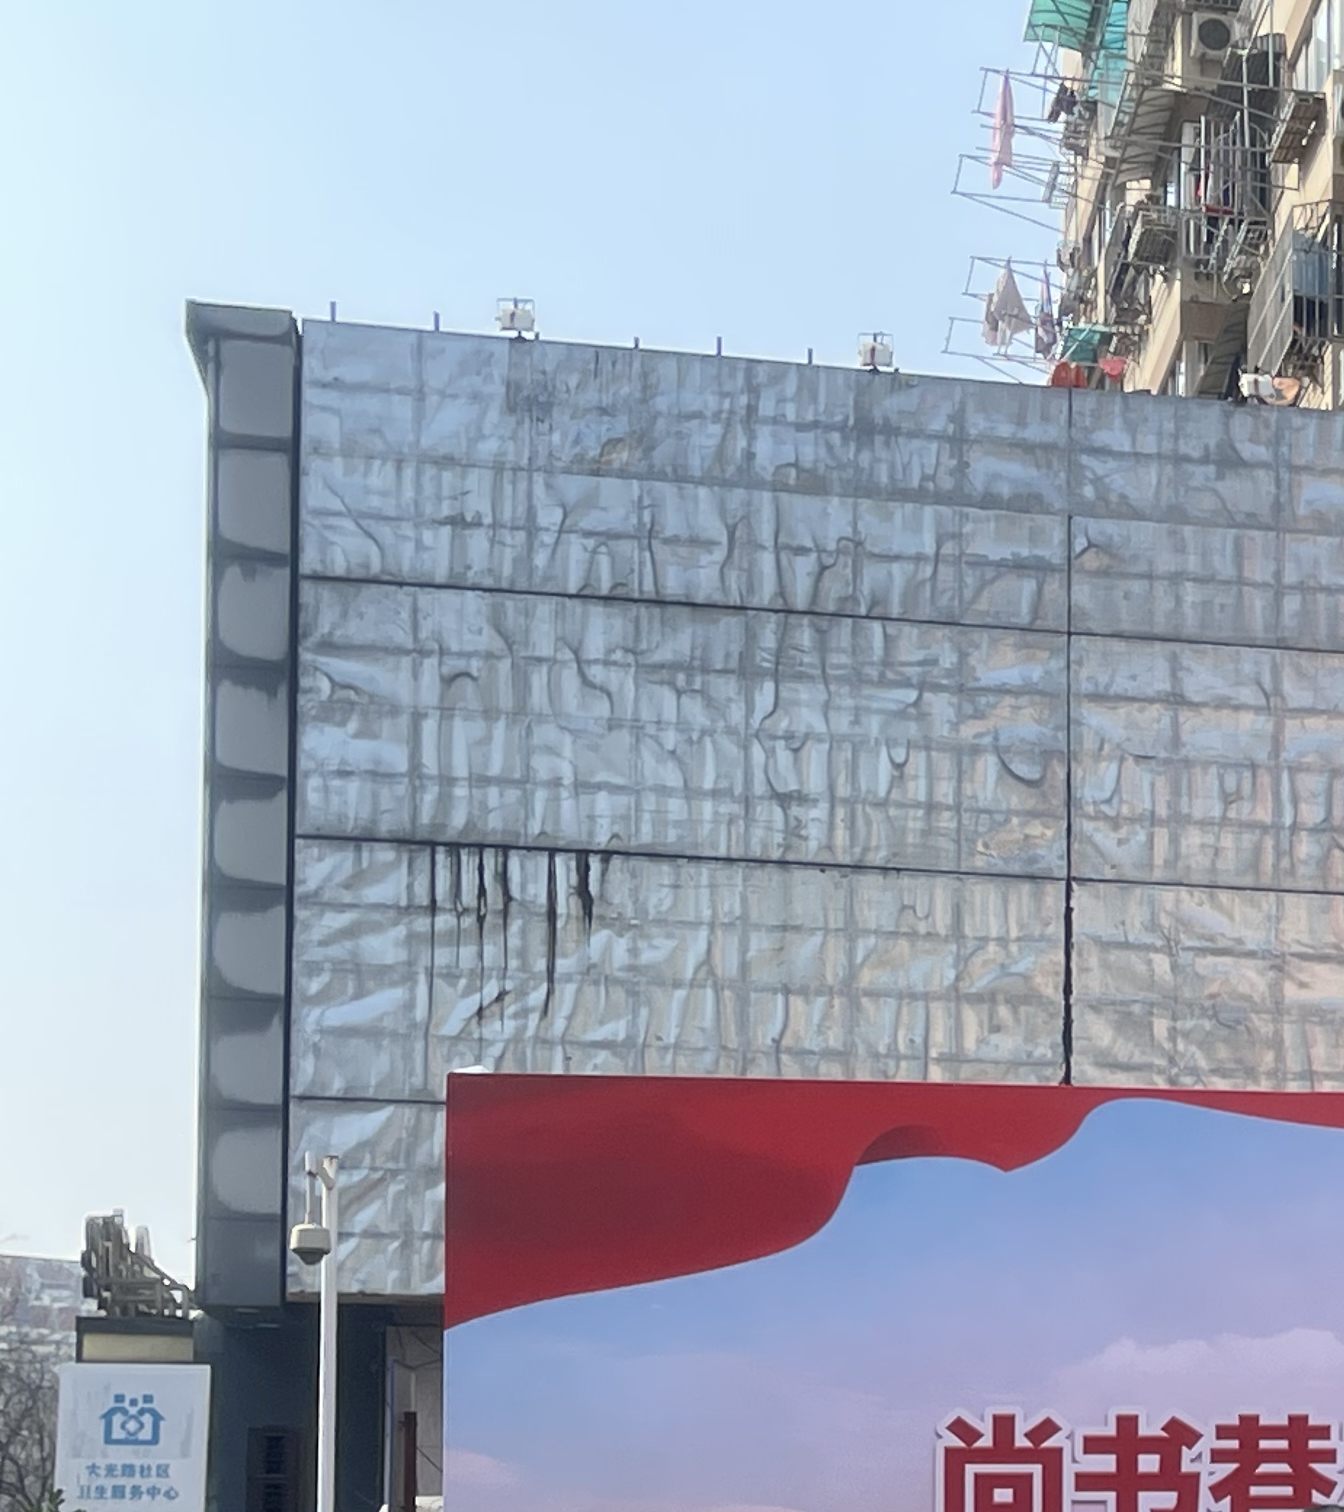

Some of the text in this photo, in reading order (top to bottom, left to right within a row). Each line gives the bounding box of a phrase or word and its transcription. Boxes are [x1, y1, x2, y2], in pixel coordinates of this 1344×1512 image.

[77, 1483, 180, 1501] 卫生服务中心
